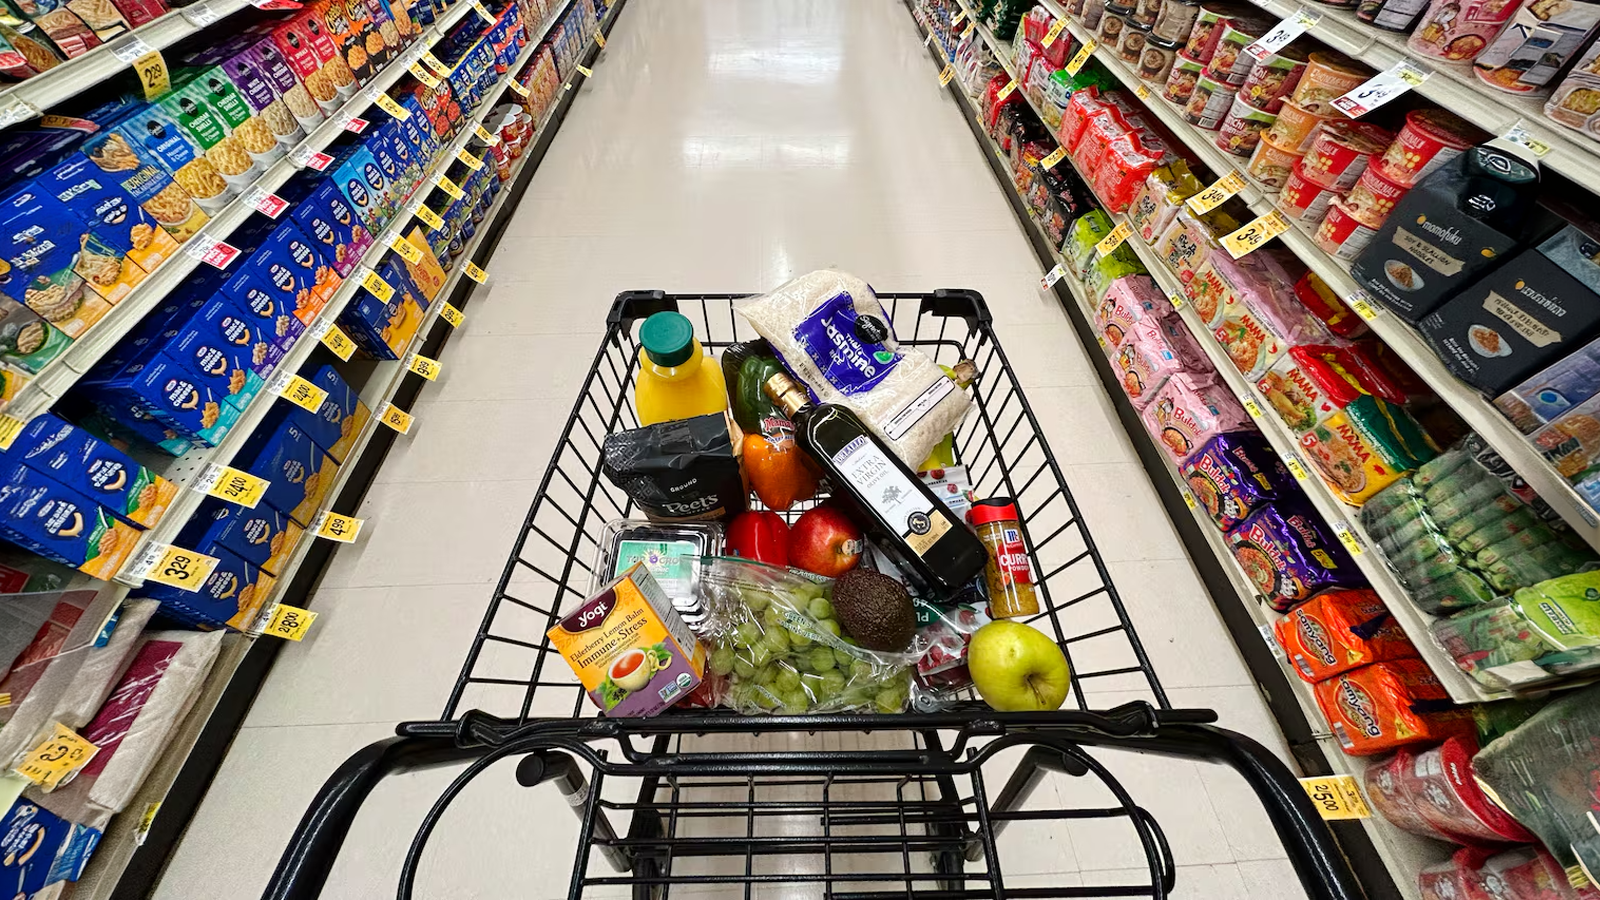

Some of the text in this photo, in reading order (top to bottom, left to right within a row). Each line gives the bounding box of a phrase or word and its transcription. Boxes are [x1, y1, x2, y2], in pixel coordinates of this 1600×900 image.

[144, 63, 161, 87] 229
[1201, 185, 1223, 207] 349
[1237, 224, 1260, 244] 349
[1423, 218, 1461, 244] momofuku
[1205, 270, 1224, 295] MAMA
[1240, 315, 1265, 343] MAMA
[822, 319, 874, 376] Jasmine
[829, 349, 843, 365] RICE
[326, 371, 335, 381] 5
[416, 361, 430, 375] 999
[1287, 369, 1317, 401] MAMA
[288, 426, 297, 437] 5
[1337, 424, 1369, 462] MAMA
[833, 435, 868, 465] DELALLO
[851, 455, 881, 478] EXTRA
[856, 460, 885, 484] VIRGIN
[866, 469, 888, 488] OLIVE OIL
[1199, 454, 1232, 493] Buldak
[670, 478, 696, 492] GROUND
[329, 518, 345, 535] 499
[1249, 524, 1290, 570] Buldak
[164, 555, 190, 579] 329
[629, 555, 679, 565] TOP CRO
[278, 612, 298, 636] 2/800
[578, 602, 607, 626] yogi
[569, 608, 643, 661] Elderberry Lemon Balm
[1297, 610, 1336, 663] samyang
[1335, 678, 1383, 737] samyang
[1313, 784, 1338, 813] 2/500
